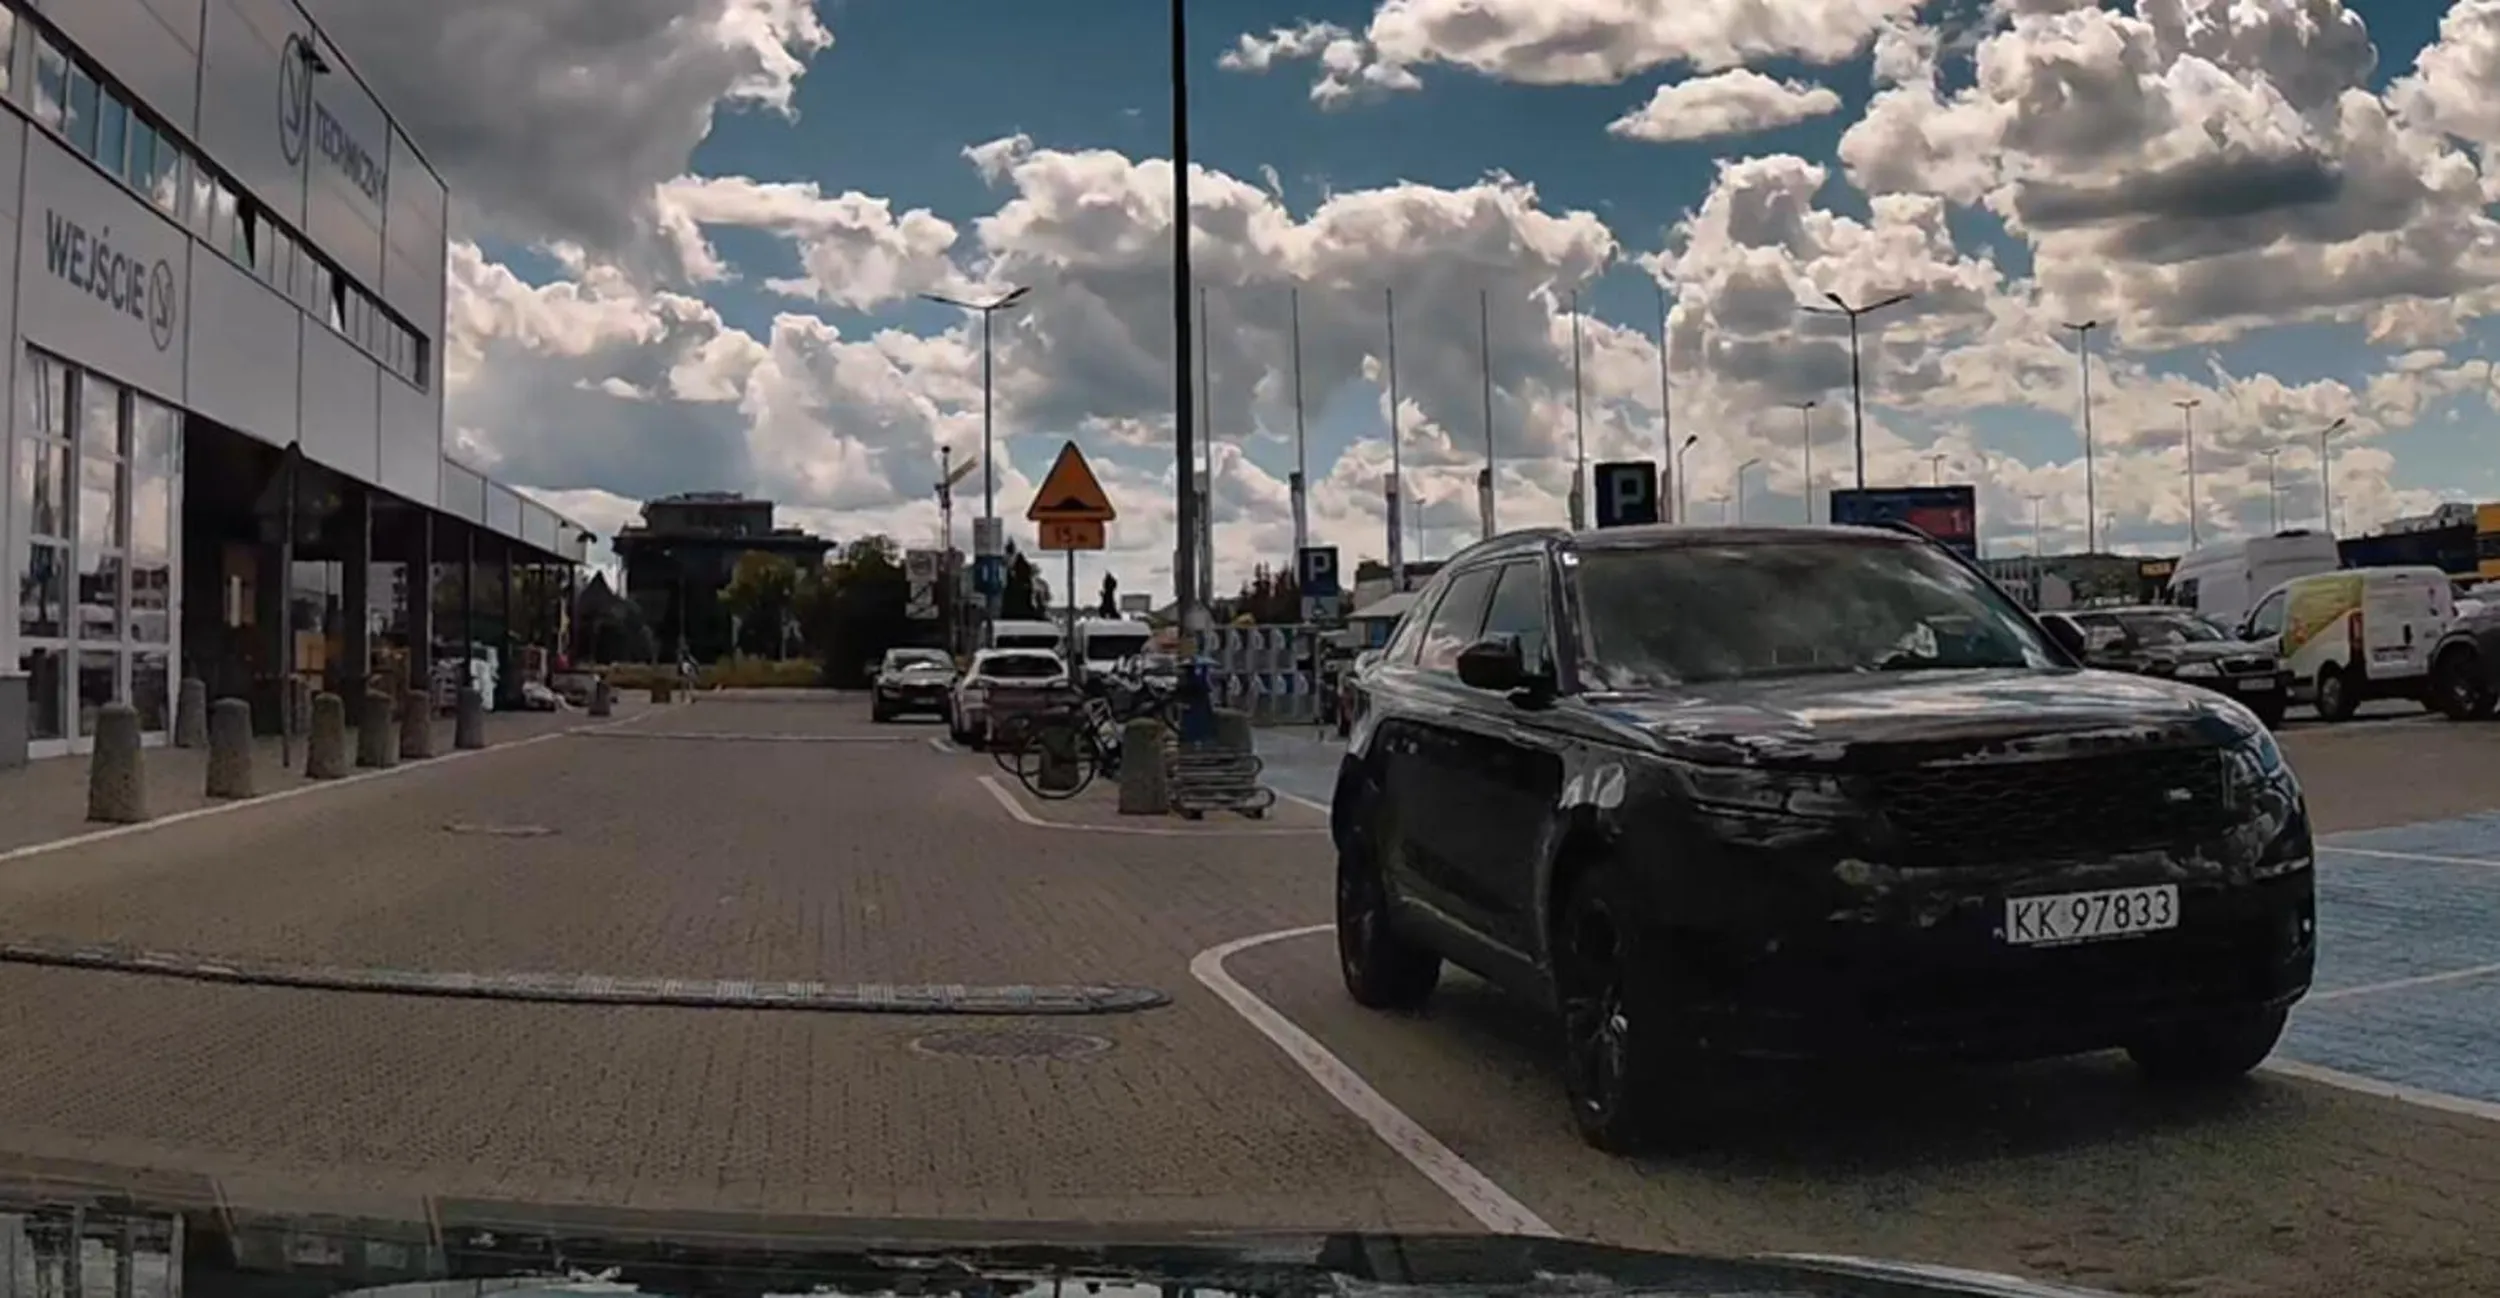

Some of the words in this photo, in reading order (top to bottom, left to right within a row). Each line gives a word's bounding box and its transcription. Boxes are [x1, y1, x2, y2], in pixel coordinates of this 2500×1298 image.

[46, 207, 145, 321] WEJŚCIE
[1612, 469, 1646, 519] P
[1308, 551, 1331, 581] P
[2014, 900, 2058, 940] KK
[2071, 889, 2171, 935] 97833
